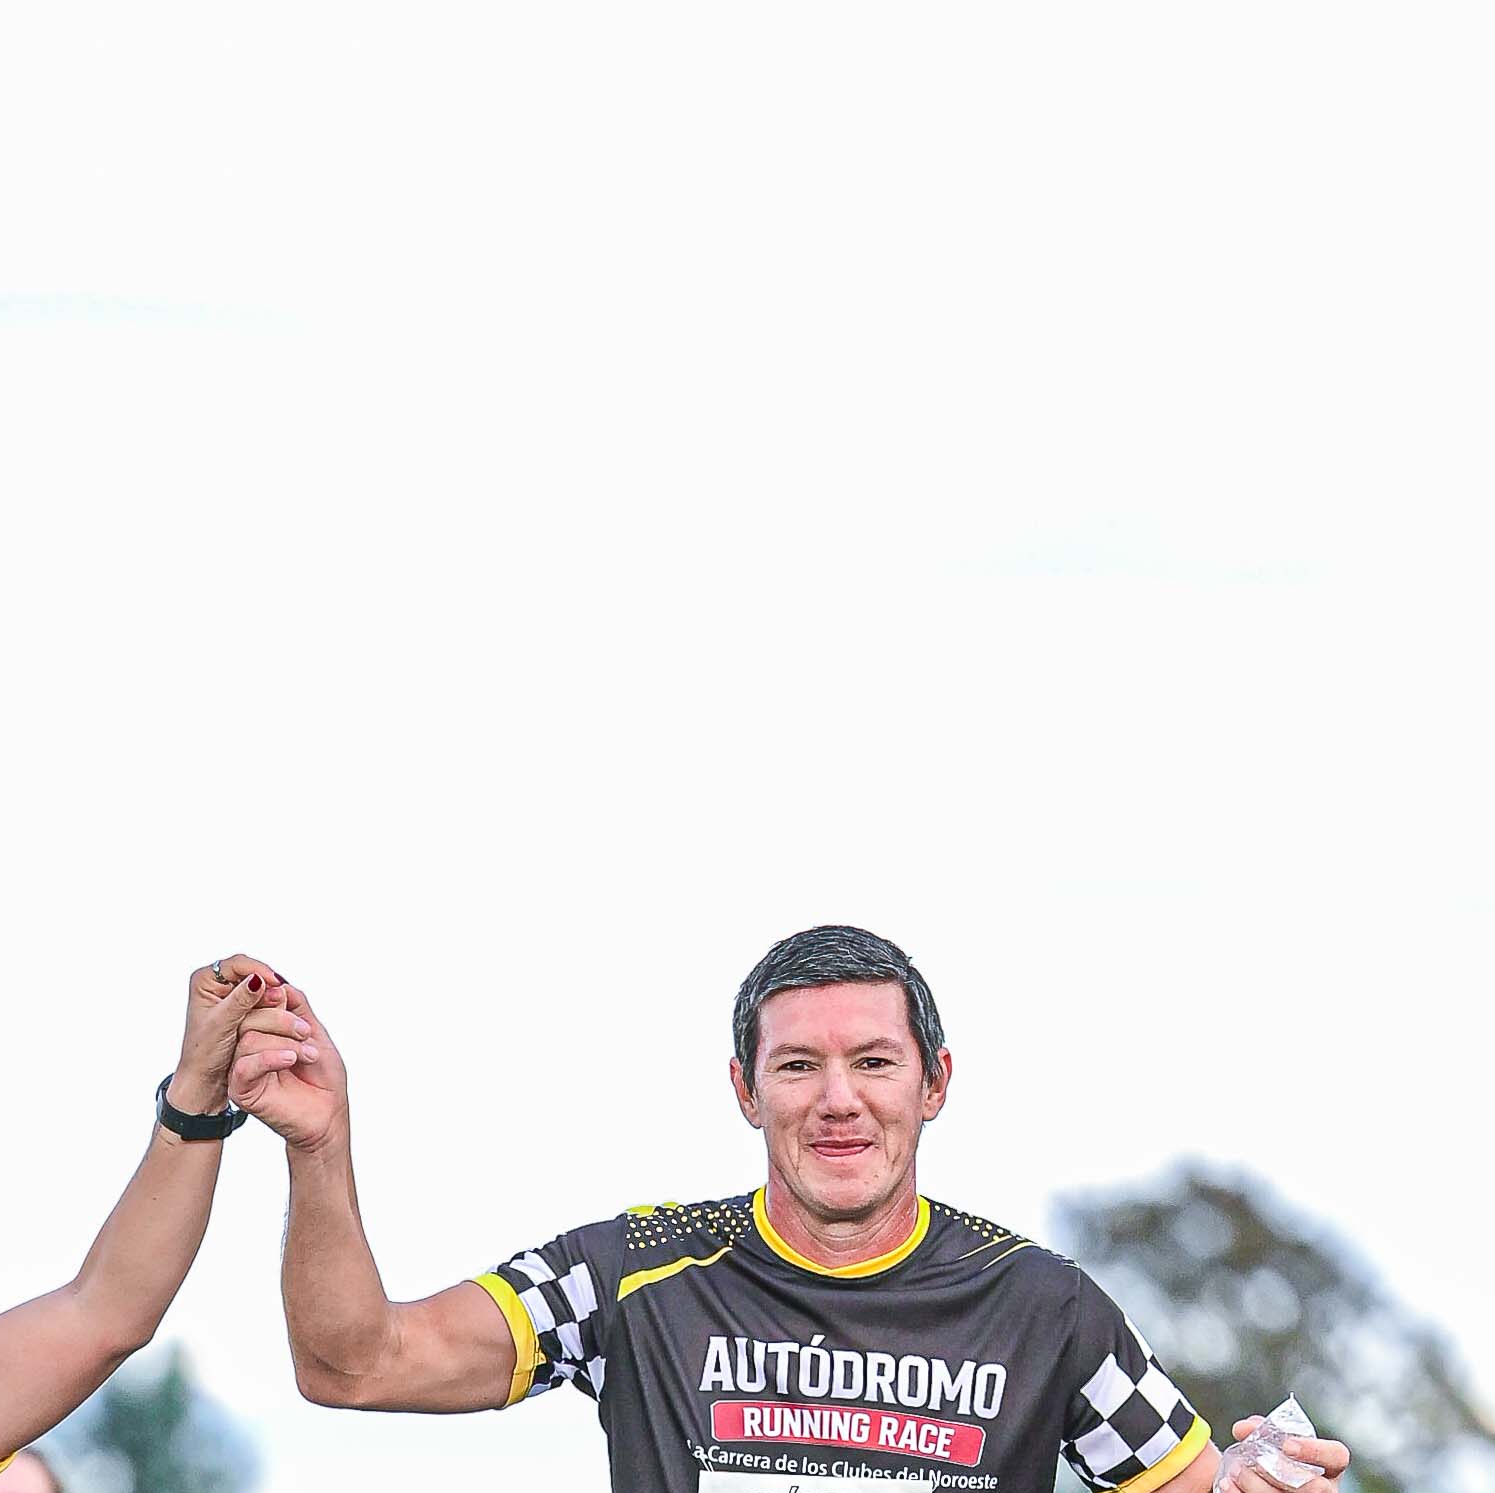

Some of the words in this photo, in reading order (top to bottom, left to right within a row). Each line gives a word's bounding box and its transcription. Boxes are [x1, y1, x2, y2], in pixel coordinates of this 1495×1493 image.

[698, 1334, 1007, 1420] AUTÓDROMO
[742, 1407, 871, 1443] RUNNING
[878, 1416, 956, 1459] RACE
[707, 1445, 771, 1469] Carrera
[775, 1454, 797, 1472] de
[802, 1457, 827, 1476] los
[929, 1469, 998, 1490] Noroeste
